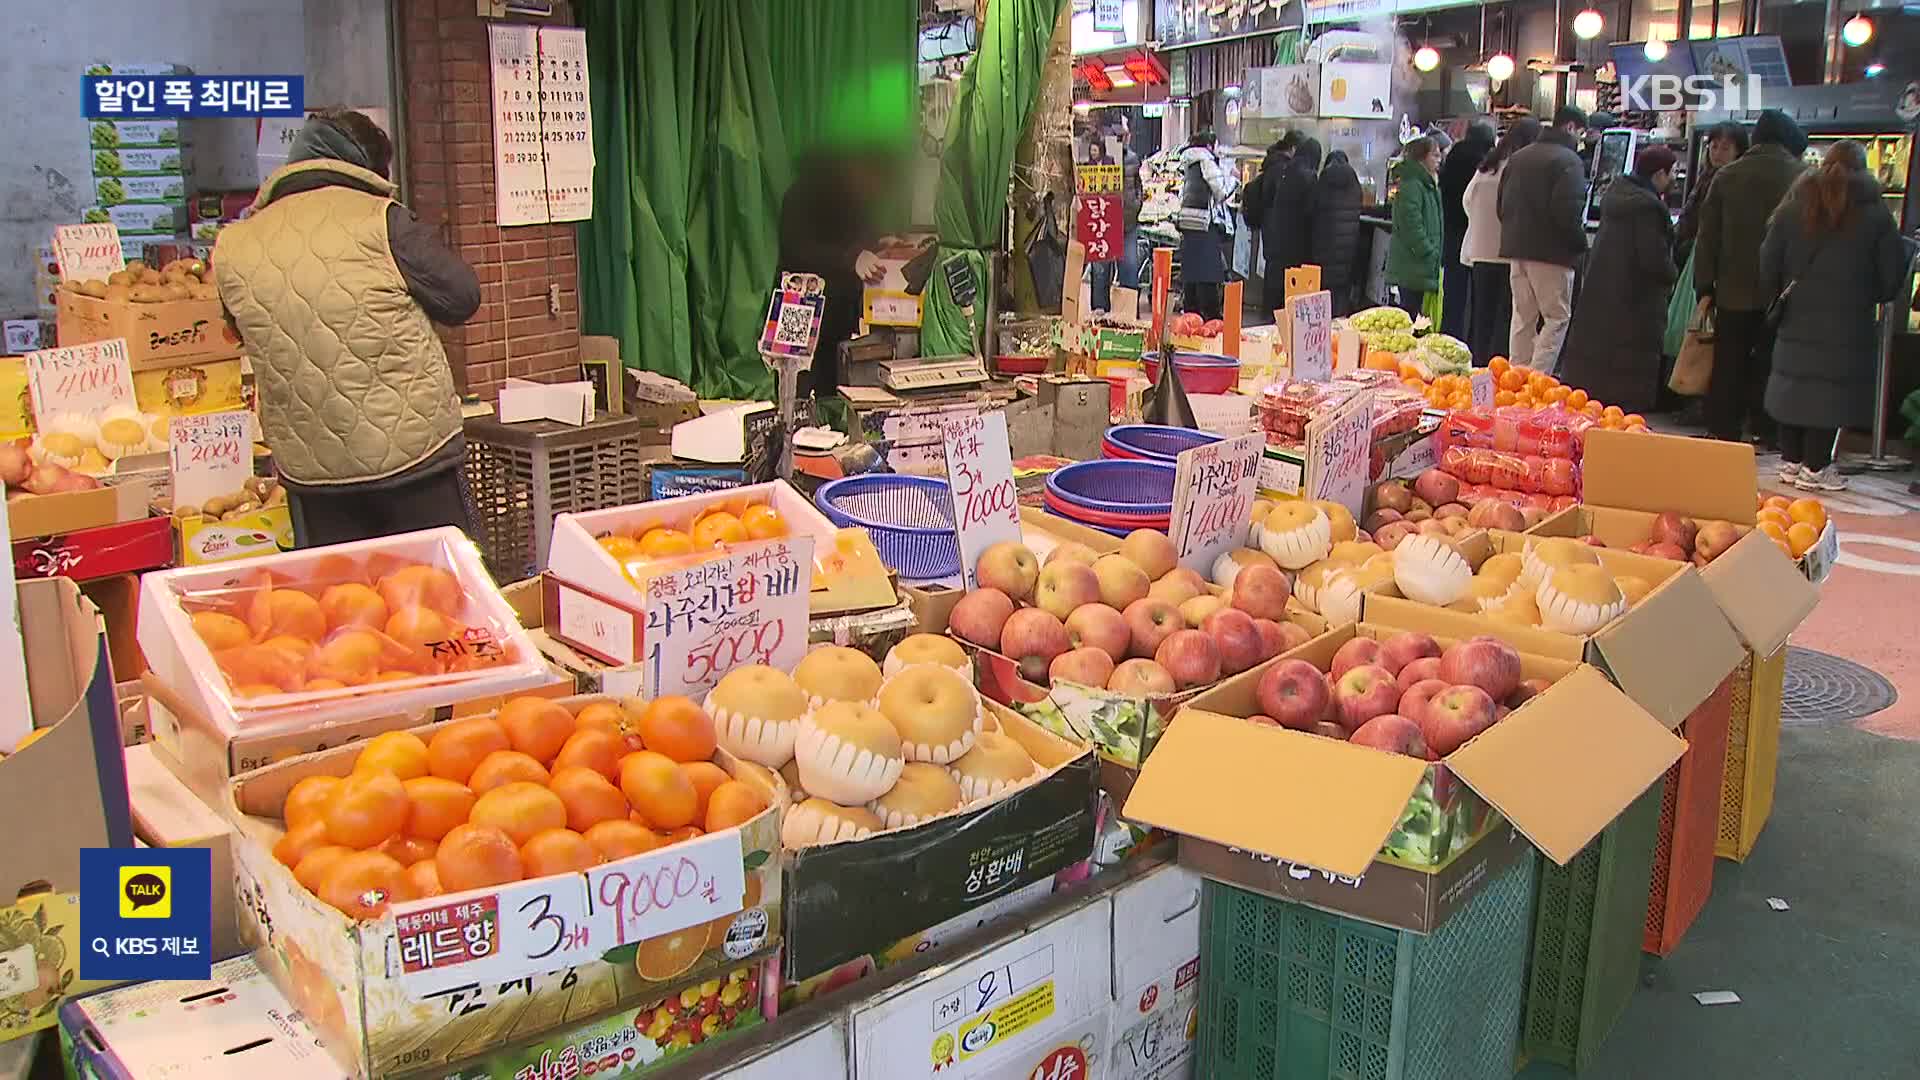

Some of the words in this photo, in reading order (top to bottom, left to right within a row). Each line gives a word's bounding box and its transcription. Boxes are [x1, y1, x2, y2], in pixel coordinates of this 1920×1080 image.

[552, 71, 557, 81] 4
[564, 71, 569, 81] 5
[527, 91, 532, 100] 9
[551, 91, 560, 100] 11
[563, 91, 572, 100] 12
[575, 92, 584, 101] 13
[503, 112, 511, 121] 14
[514, 112, 523, 121] 15
[526, 112, 535, 121] 16
[551, 112, 561, 121] 18
[564, 112, 573, 121] 19
[576, 112, 585, 121] 20
[504, 132, 513, 143] 21
[515, 131, 525, 142] 22
[527, 131, 536, 142] 23
[551, 131, 562, 142] 25
[564, 131, 574, 142] 26
[576, 131, 586, 142] 27
[516, 153, 526, 163] 29
[527, 153, 538, 163] 30
[1086, 197, 1111, 259] 닭강정
[953, 435, 985, 459] 사과
[742, 543, 792, 569] 제수용
[424, 639, 504, 661] 제주
[965, 848, 1024, 893] 성환배
[455, 903, 485, 921] 제주
[402, 918, 496, 969] 레드향
[939, 997, 960, 1018] 수량
[392, 1048, 431, 1067] 10kg
